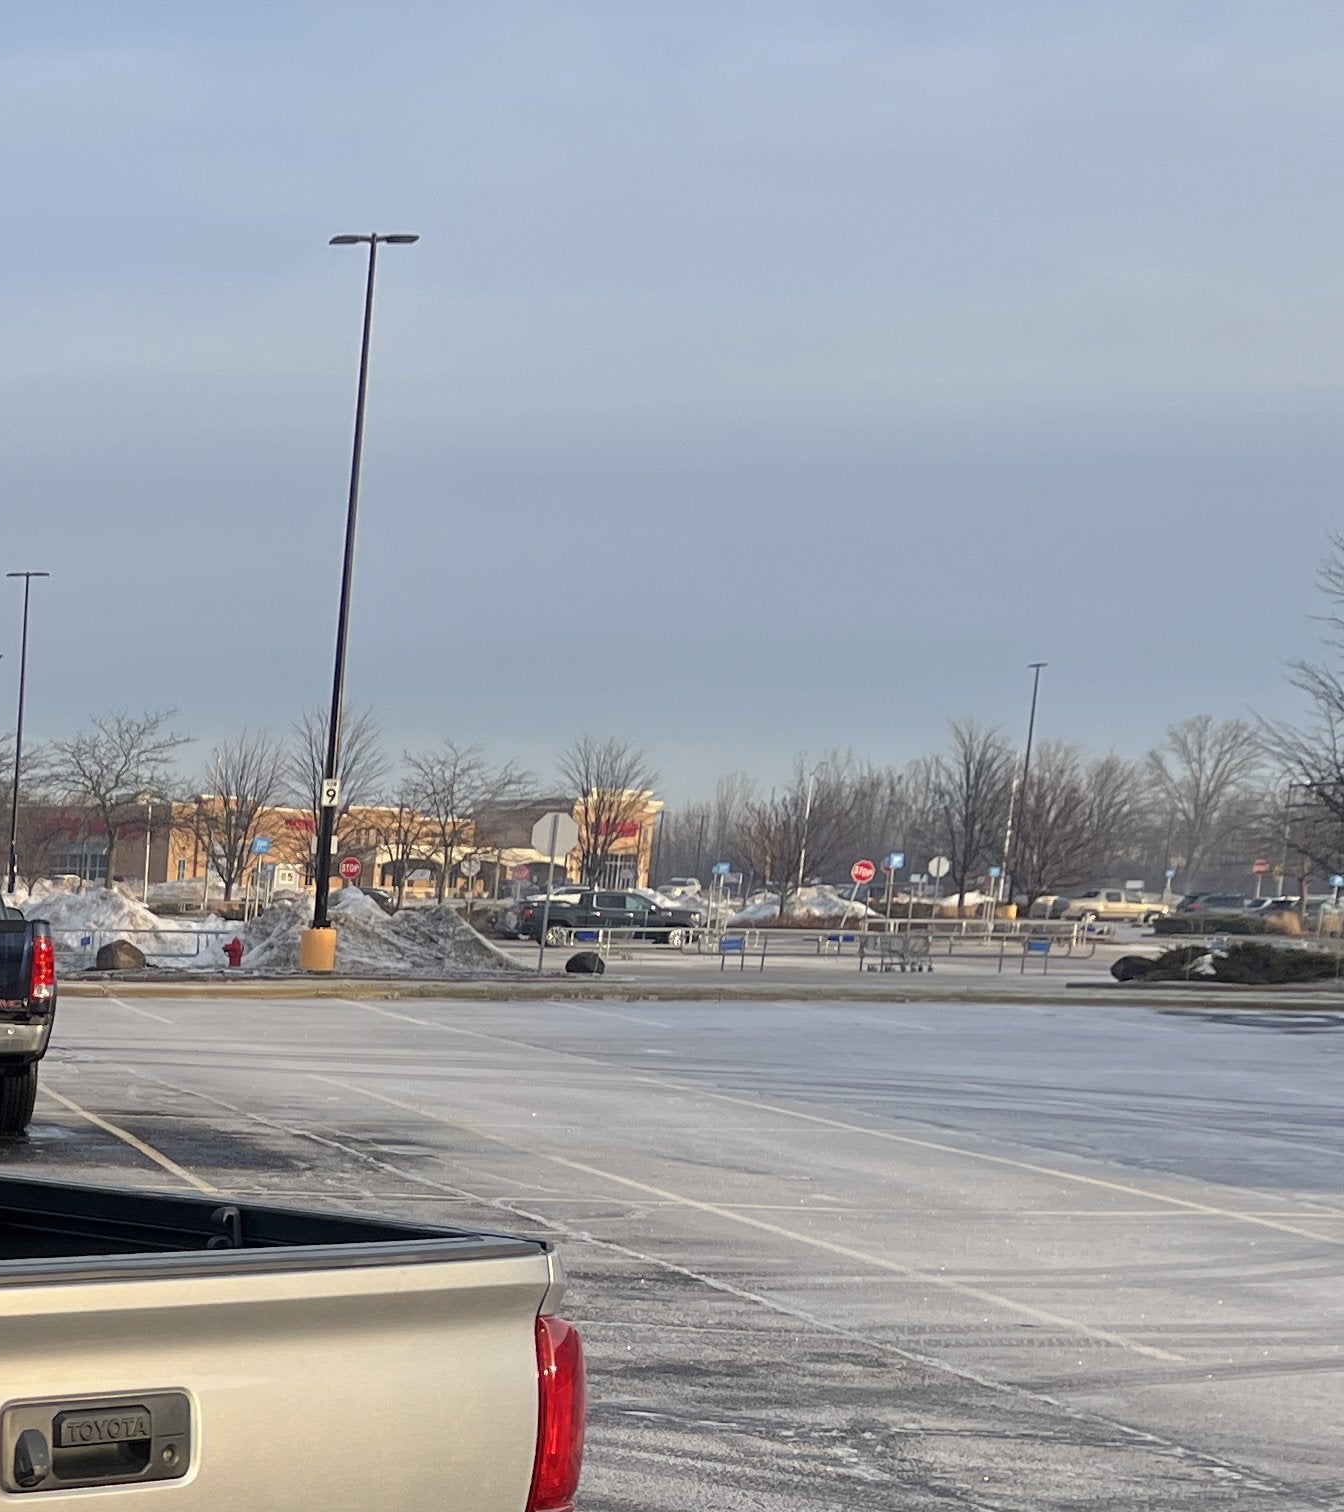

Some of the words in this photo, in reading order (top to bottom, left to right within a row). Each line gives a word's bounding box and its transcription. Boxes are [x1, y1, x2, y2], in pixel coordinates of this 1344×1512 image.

[326, 788, 336, 804] 9
[341, 863, 360, 873] STOP
[853, 864, 874, 878] STOP
[66, 1416, 148, 1443] TOYOTA
